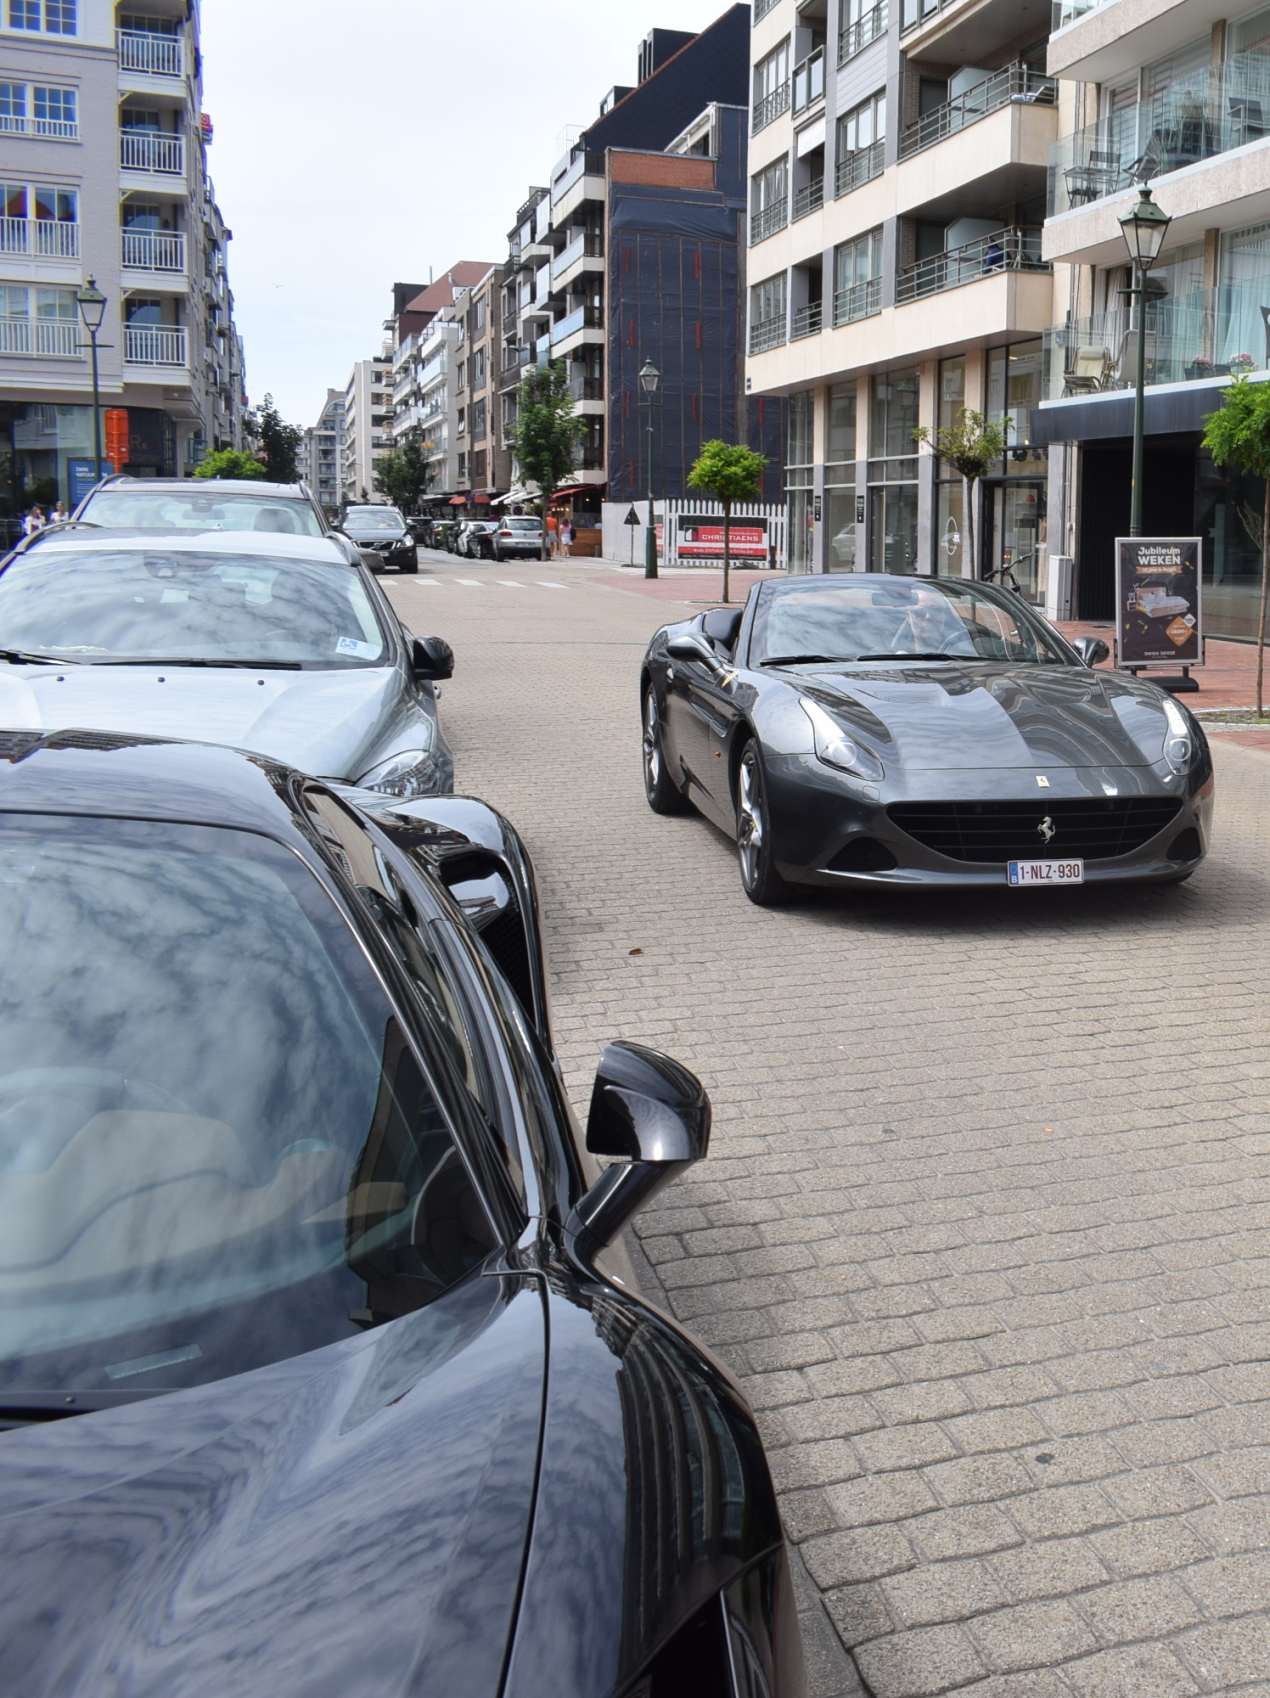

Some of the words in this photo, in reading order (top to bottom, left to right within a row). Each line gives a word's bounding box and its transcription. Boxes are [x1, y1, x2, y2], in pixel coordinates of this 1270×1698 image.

[701, 534, 759, 542] CHRITIAENS
[1138, 547, 1180, 555] Jubileum
[1138, 556, 1181, 565] WEKEN
[1020, 864, 1080, 879] 1-NLZ-930
